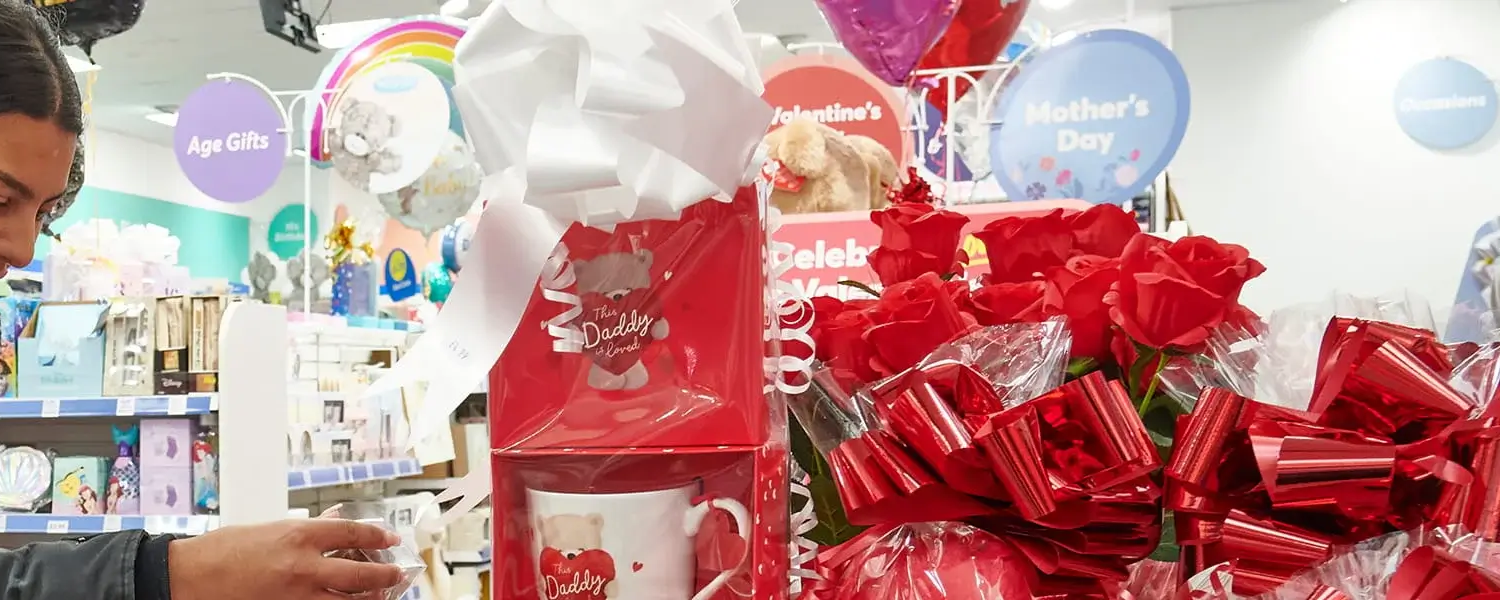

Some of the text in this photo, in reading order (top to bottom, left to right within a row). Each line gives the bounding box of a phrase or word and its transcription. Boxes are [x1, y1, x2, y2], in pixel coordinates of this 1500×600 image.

[1025, 93, 1150, 127] Mother's
[186, 130, 269, 158] Age Gifts
[1057, 129, 1116, 155] Day
[593, 304, 617, 320] This
[582, 309, 653, 348] Daddy
[596, 336, 641, 357] is loved
[553, 562, 571, 575] This
[546, 569, 606, 600] Daddy
